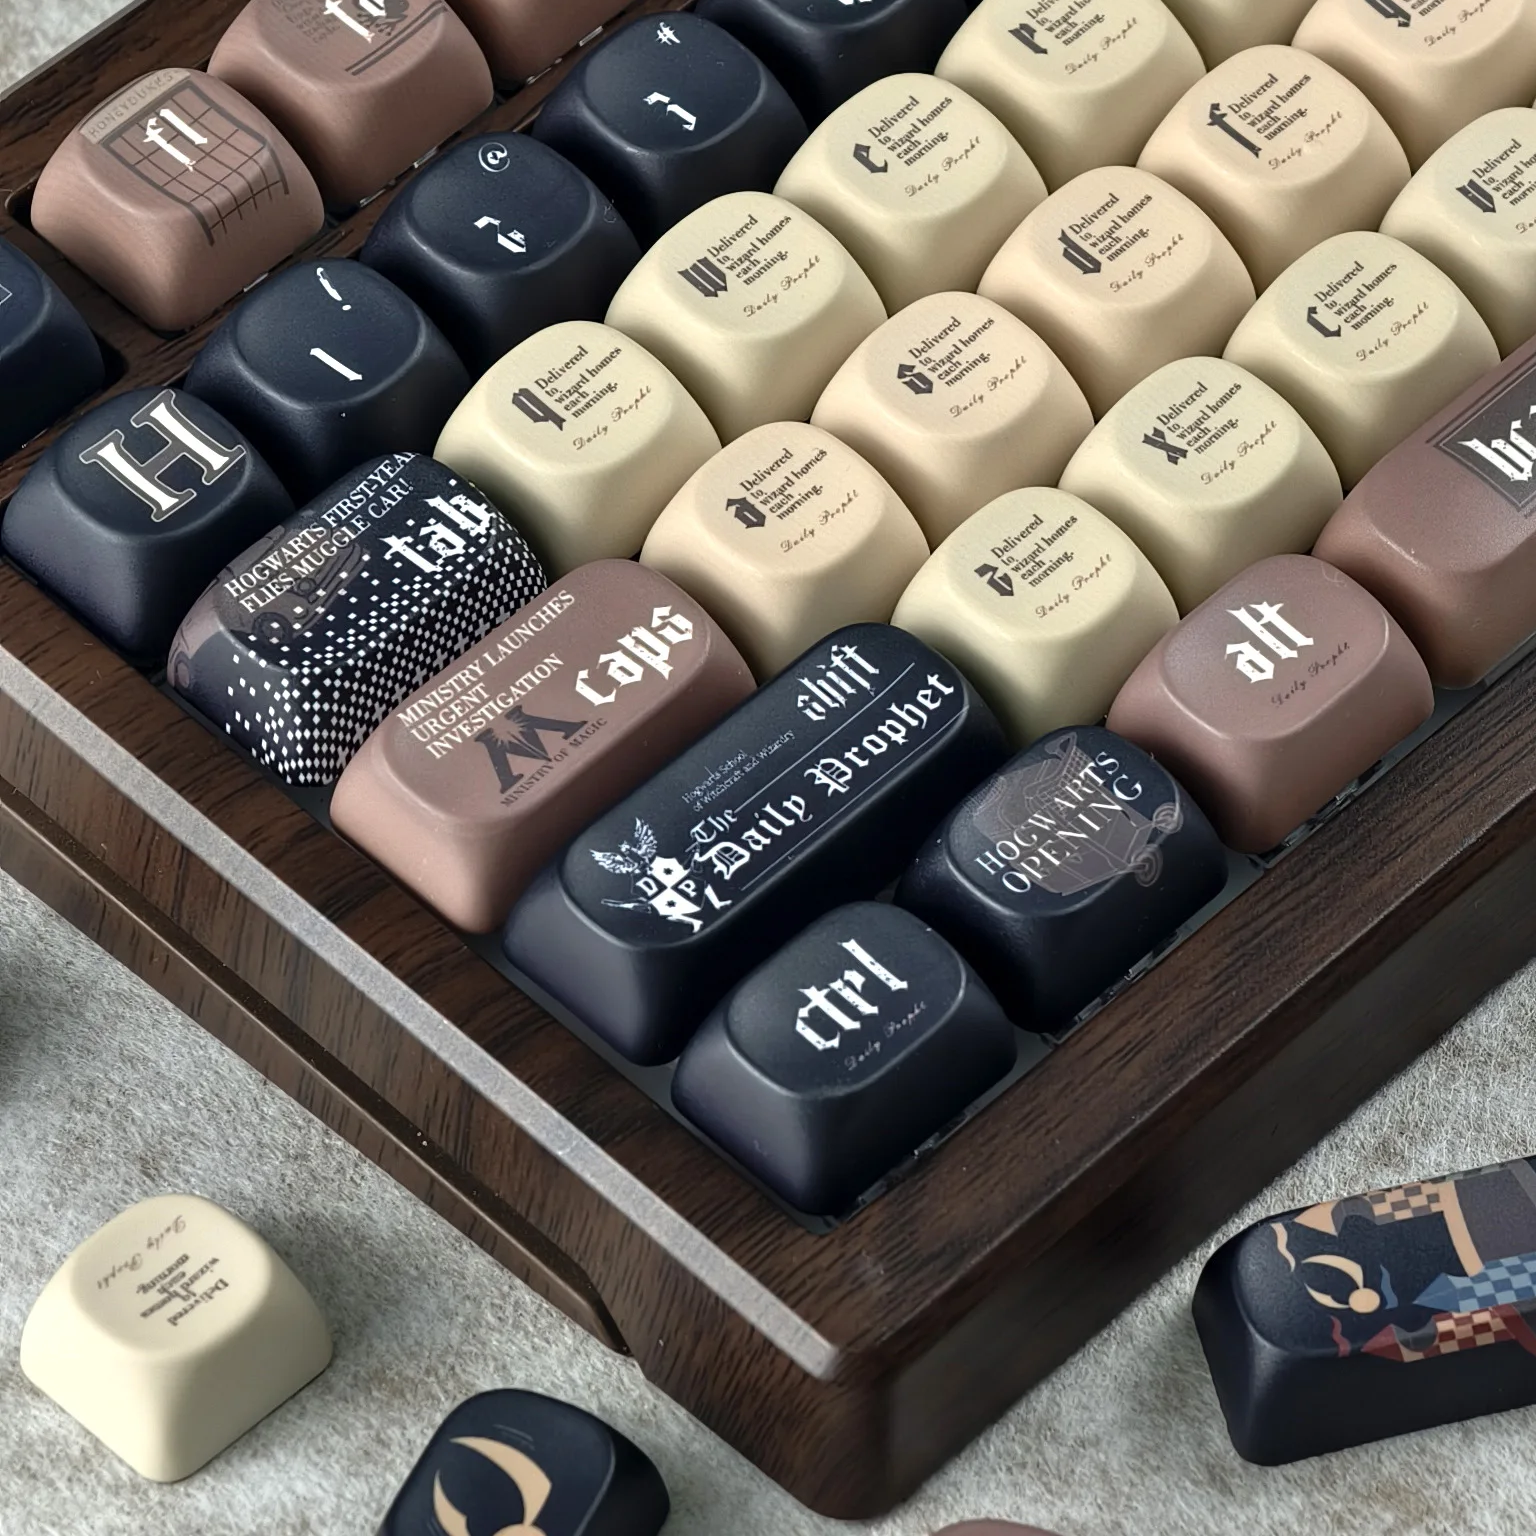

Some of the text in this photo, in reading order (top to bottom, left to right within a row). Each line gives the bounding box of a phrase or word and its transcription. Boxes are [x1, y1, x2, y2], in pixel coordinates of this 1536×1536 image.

[1045, 5, 1078, 33] wizard
[1054, 21, 1078, 40] each
[1062, 14, 1105, 46] morning.
[478, 143, 510, 173] @
[1314, 260, 1365, 303] Delivered
[1333, 264, 1397, 317] wizard homes
[908, 316, 962, 359] Delivered
[1343, 304, 1367, 324] each
[1350, 297, 1395, 330] morning.
[534, 345, 589, 390] Delivered
[927, 317, 995, 374] wizard homes
[937, 361, 962, 381] each
[944, 352, 991, 387] morning.
[554, 347, 622, 405] wizard homes
[564, 390, 590, 411] each
[571, 382, 618, 419] morning.
[81, 388, 246, 522] H
[224, 452, 420, 598] HOGWARTS FIRST-YEA
[240, 477, 415, 614] FLIES MUGGLE CAR!
[379, 493, 496, 574] tab
[396, 589, 576, 728] MINISTRY LAUNCHES
[574, 605, 693, 707] caps
[1224, 600, 1315, 684] alt
[410, 683, 490, 743] URGENT
[426, 653, 565, 760] INVESTIGATION
[500, 718, 608, 808] MINISTRY OF MAGIC
[682, 749, 748, 803] Hogwarts School
[693, 801, 704, 812] of
[700, 770, 744, 804] Witchcraft
[742, 755, 760, 773] and
[695, 672, 955, 880] Daily Prophet
[690, 808, 738, 844] The
[974, 751, 1120, 875] HOGWARTS
[1001, 774, 1143, 893] OPENING
[795, 938, 908, 1051] ctrl
